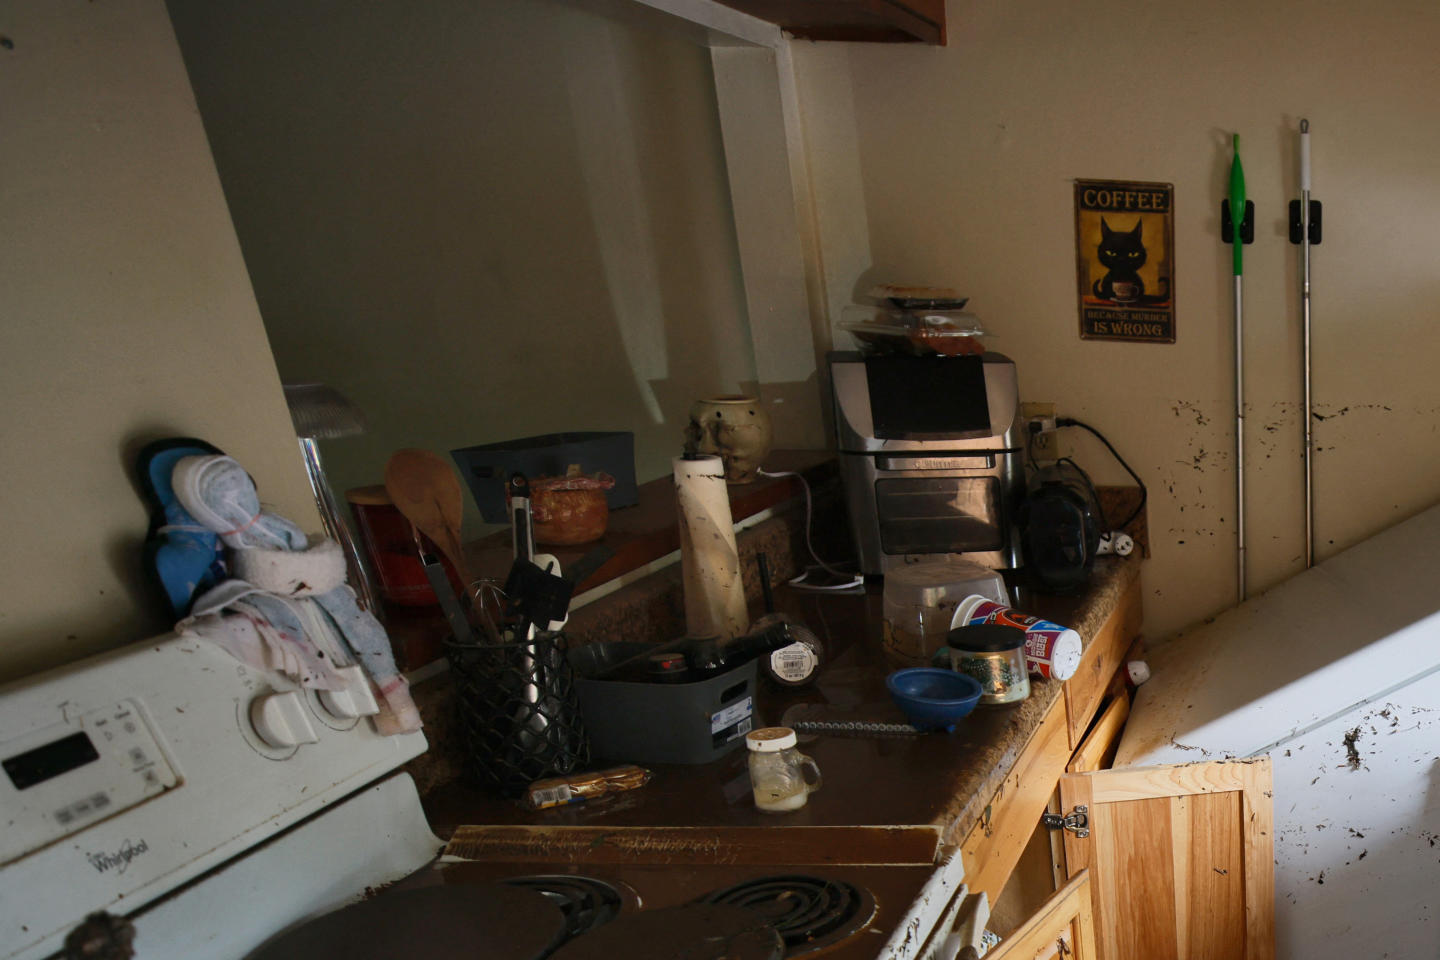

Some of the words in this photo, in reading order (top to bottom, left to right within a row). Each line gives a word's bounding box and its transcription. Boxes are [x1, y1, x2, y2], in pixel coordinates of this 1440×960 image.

[1084, 189, 1164, 209] COFFEE
[1088, 311, 1128, 320] BECAUSE
[1094, 320, 1108, 333] IS
[1111, 321, 1163, 336] WRONG
[90, 839, 149, 874] Whirlpool
